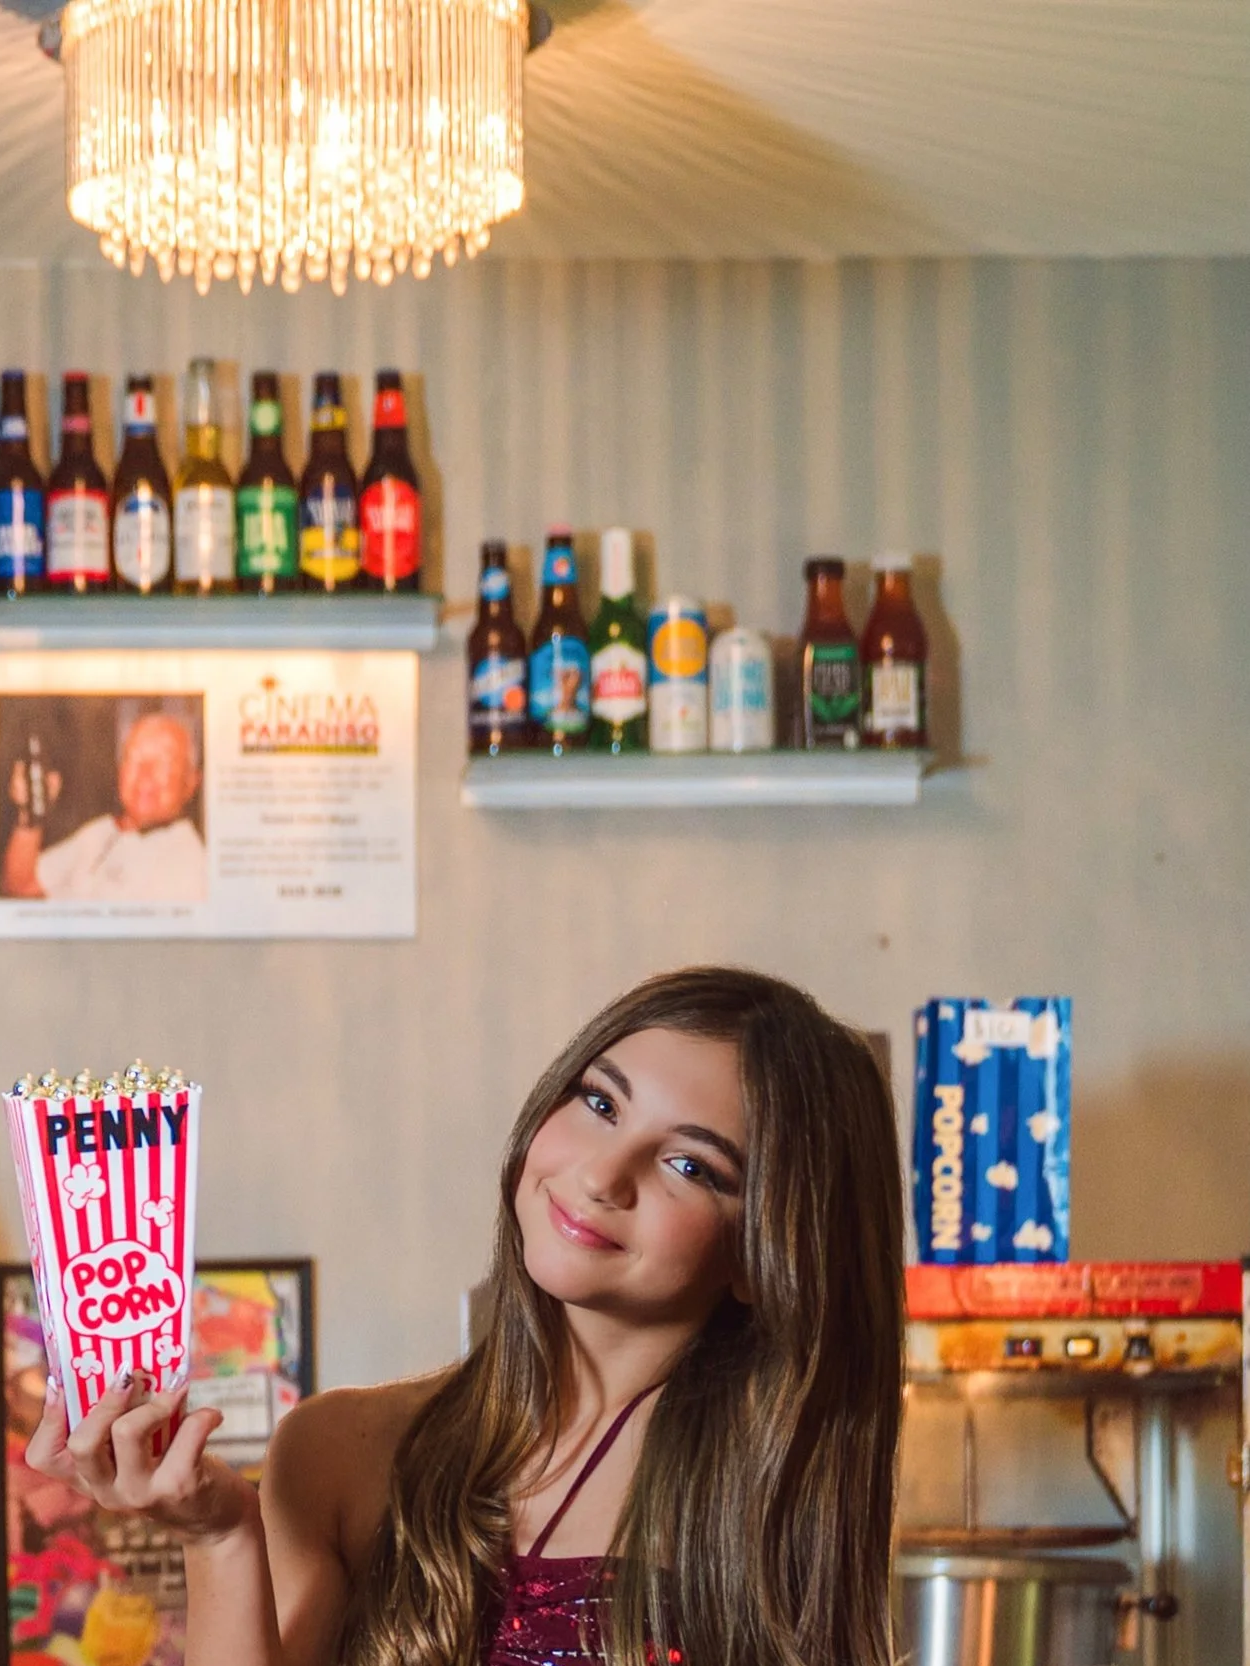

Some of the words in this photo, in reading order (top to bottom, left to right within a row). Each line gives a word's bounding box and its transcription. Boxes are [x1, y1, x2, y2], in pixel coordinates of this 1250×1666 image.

[46, 1103, 190, 1156] PENNY
[931, 1083, 965, 1251] POPCORN
[71, 1250, 147, 1298] POP
[77, 1279, 176, 1331] CORN
